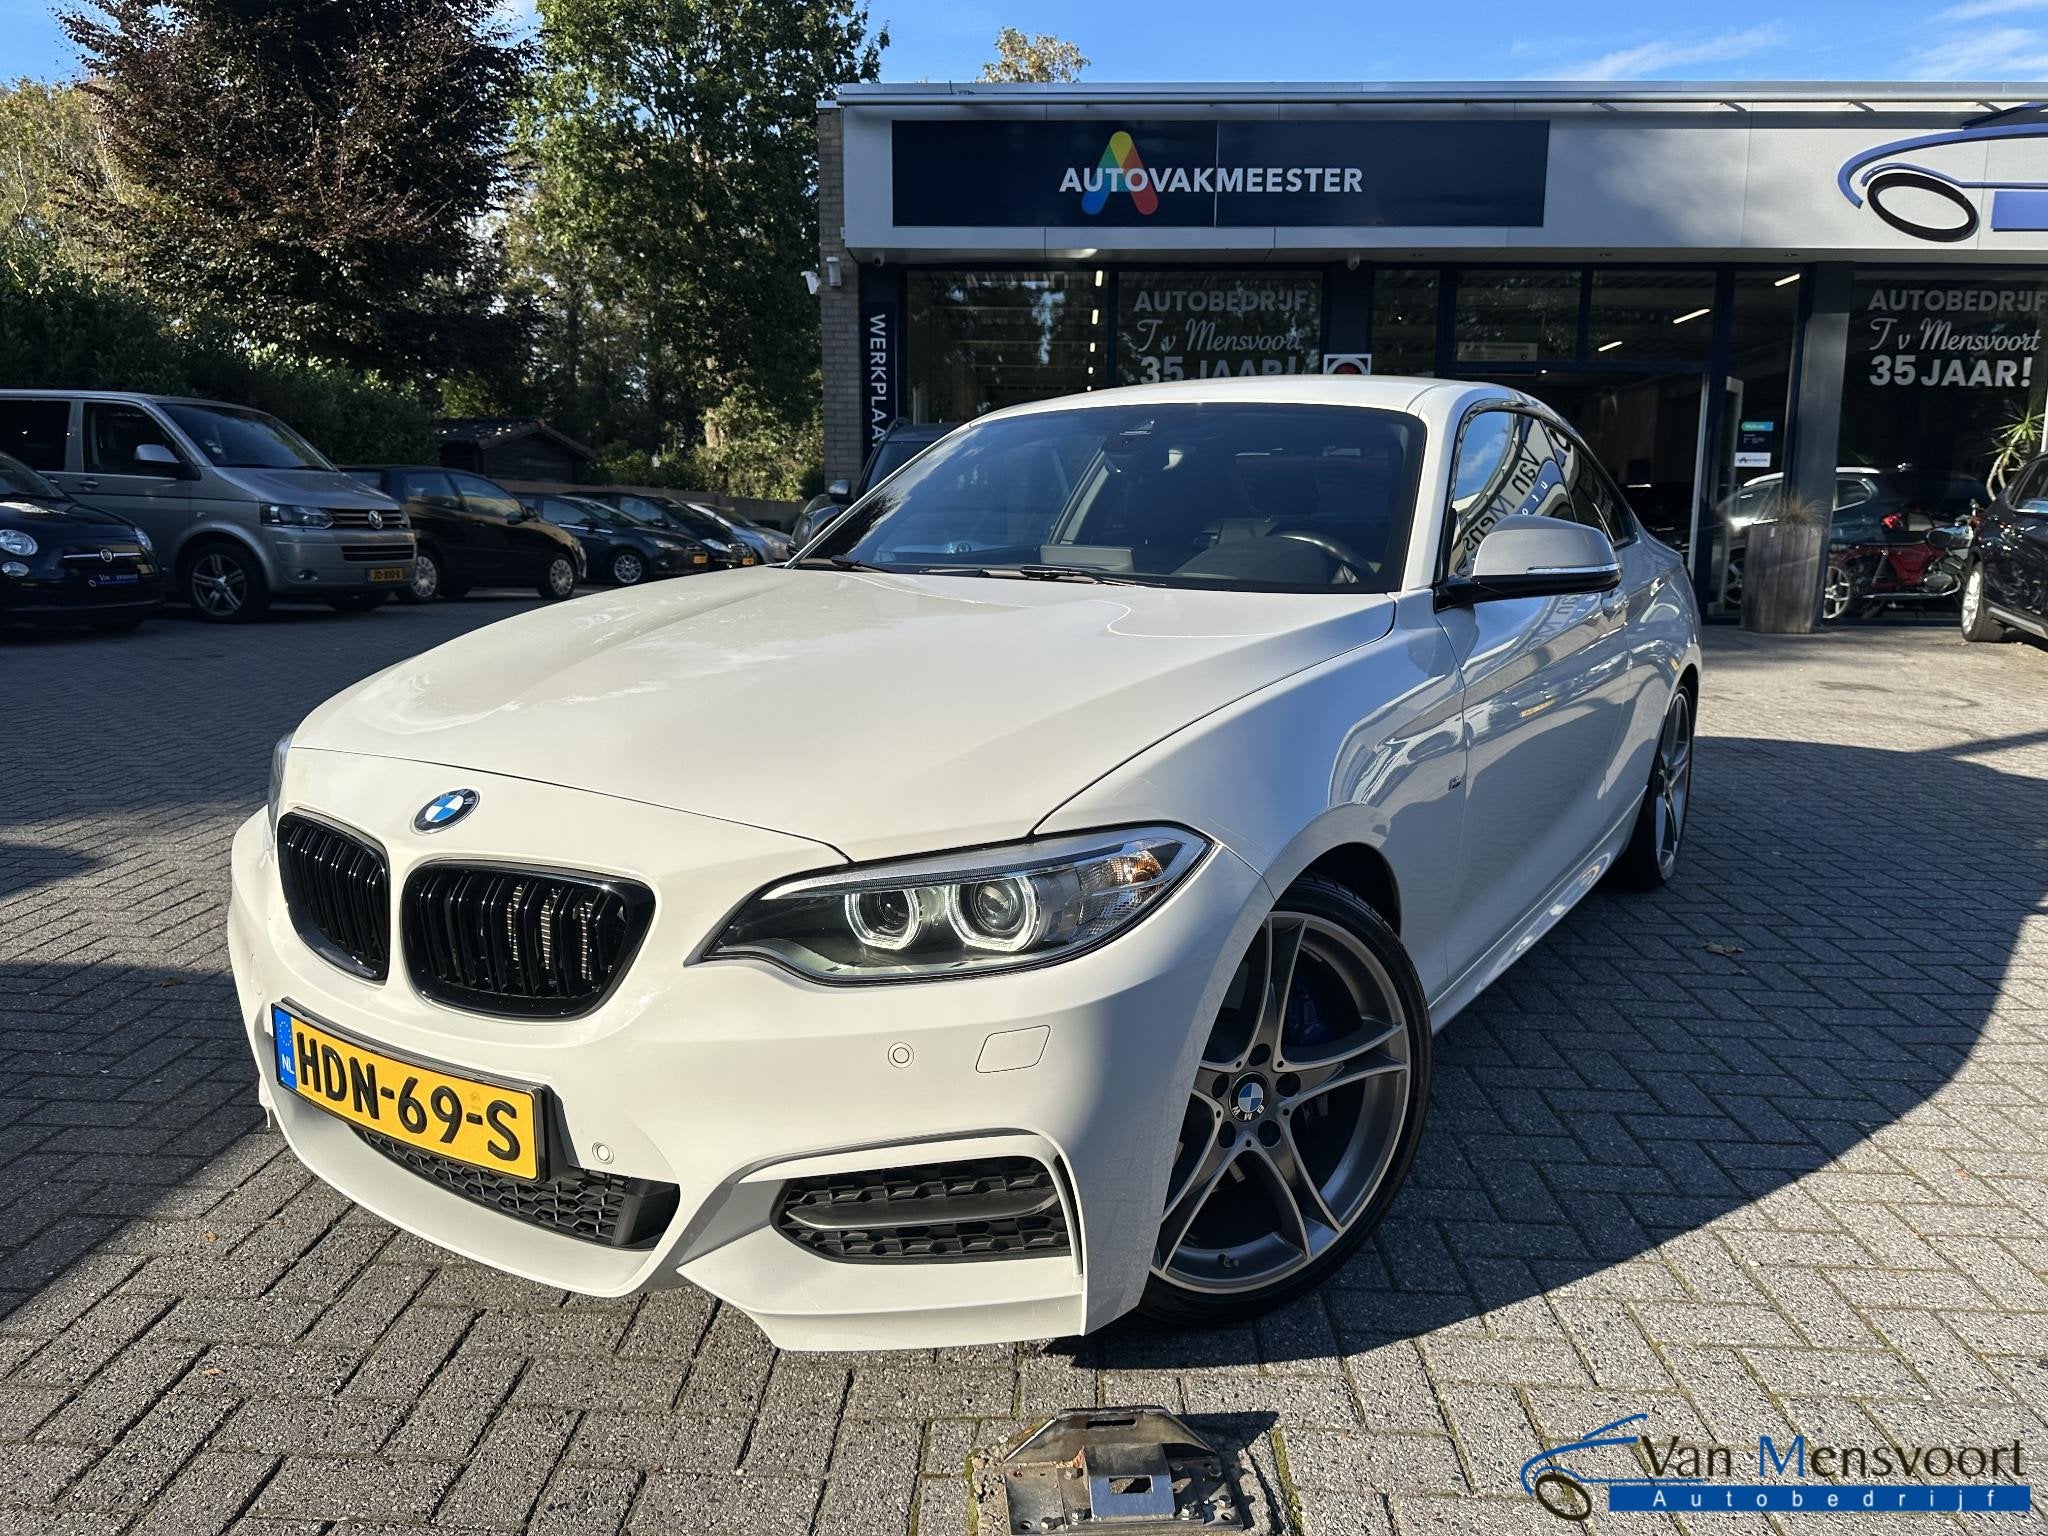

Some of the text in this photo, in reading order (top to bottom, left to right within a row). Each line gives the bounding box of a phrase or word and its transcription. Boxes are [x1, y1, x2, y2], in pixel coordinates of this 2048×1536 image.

[1058, 167, 1364, 193] AUTOVAKMEESTER
[1132, 290, 1310, 312] AUTOBEDRIJF
[1867, 289, 2048, 312] AUTOBEDRIJF
[1185, 318, 1302, 352] Mensvoort
[1869, 317, 1898, 351] T
[1919, 317, 2042, 352] Mensvoort
[869, 313, 888, 448] WERKPLAA
[1139, 356, 1185, 384] 35
[1869, 354, 2033, 388] 35 JAAR!
[281, 1053, 296, 1076] NL
[296, 1031, 521, 1162] HDN-69-S
